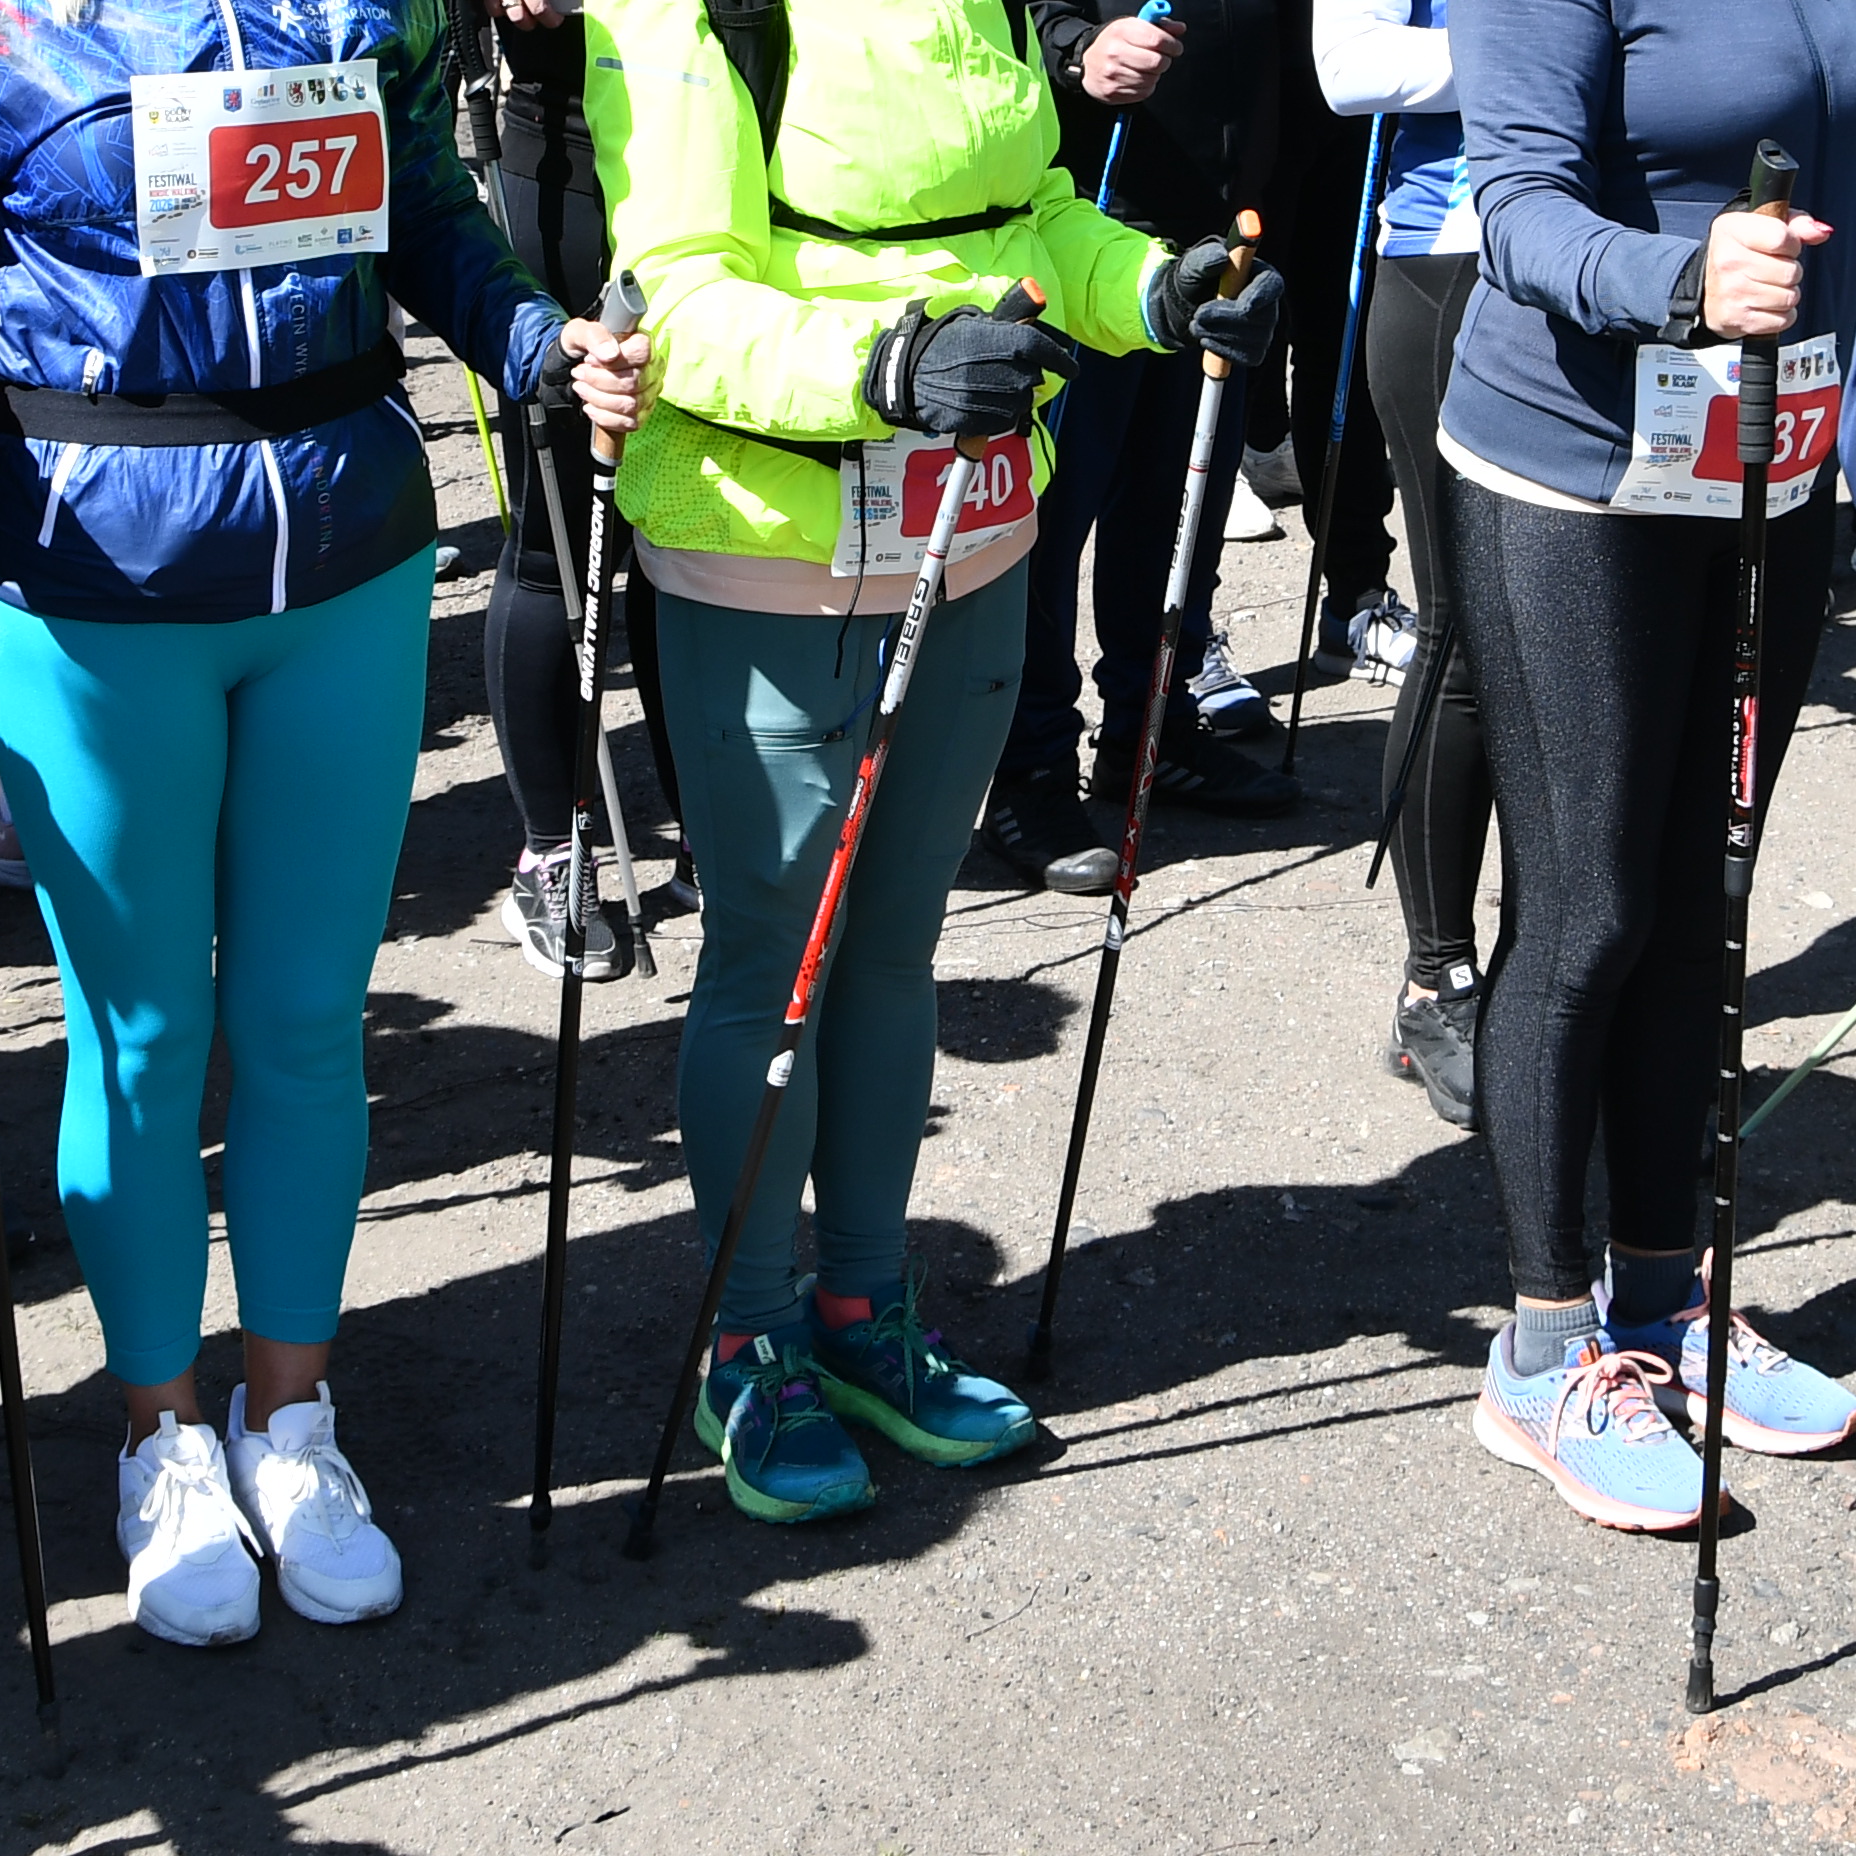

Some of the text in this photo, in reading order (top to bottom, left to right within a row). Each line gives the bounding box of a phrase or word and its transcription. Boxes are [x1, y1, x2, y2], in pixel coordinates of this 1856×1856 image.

[148, 173, 198, 188] FESTIWAL
[243, 134, 358, 205] 257
[148, 198, 174, 213] 2026
[283, 263, 306, 336] ZCZECIN
[1650, 432, 1693, 447] FESTIWAL
[1771, 405, 1827, 465] 37
[579, 495, 605, 702] NORDIC WALKING
[893, 577, 931, 675] GABEL
[847, 776, 865, 820] CARBON
